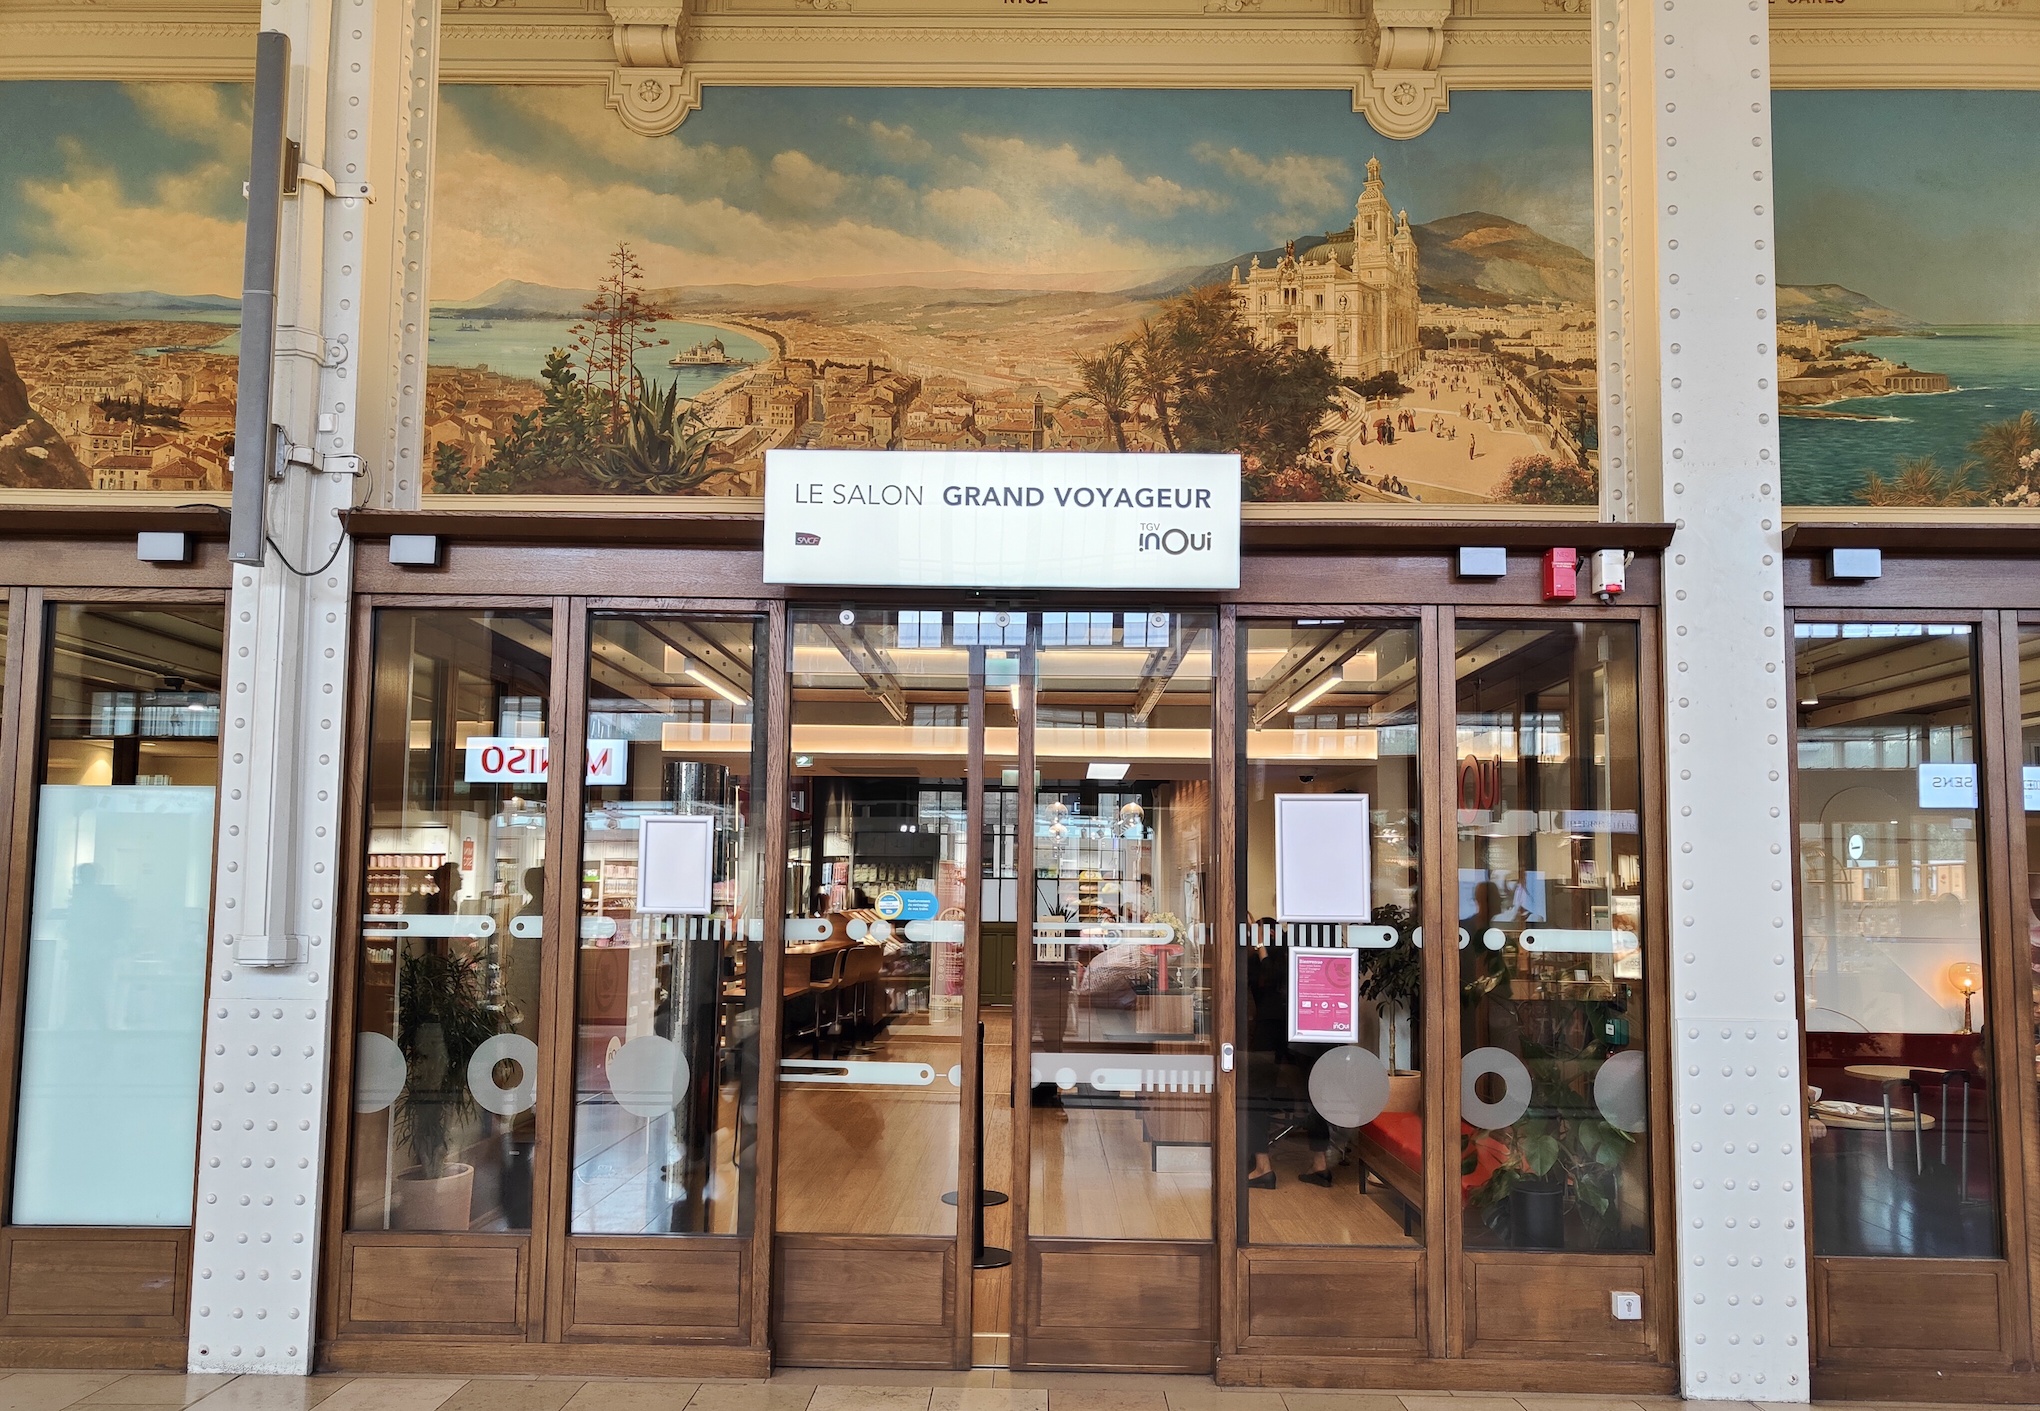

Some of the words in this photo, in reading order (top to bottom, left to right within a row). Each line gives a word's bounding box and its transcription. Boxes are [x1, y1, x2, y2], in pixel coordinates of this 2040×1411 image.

[796, 483, 823, 504] LE
[833, 484, 923, 506] SALON
[943, 486, 1045, 507] GRAND
[1054, 487, 1211, 509] VOYAGEUR
[1140, 522, 1161, 531] TGV
[796, 536, 820, 545] SNCF
